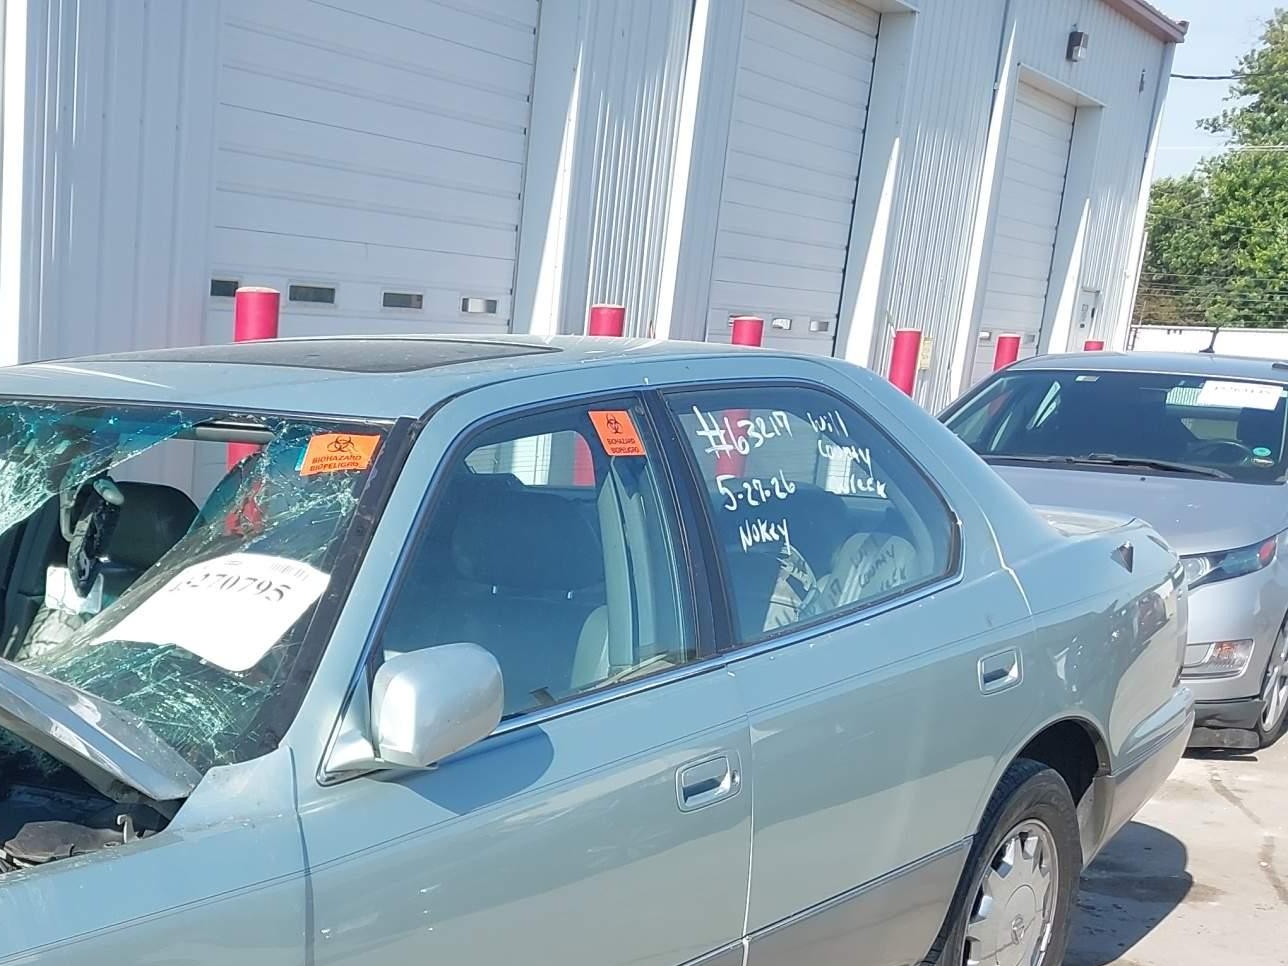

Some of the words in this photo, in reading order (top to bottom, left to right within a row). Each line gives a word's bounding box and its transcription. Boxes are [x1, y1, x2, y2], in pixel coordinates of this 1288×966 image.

[693, 405, 793, 459] #63217
[806, 410, 849, 438] Will
[312, 455, 362, 464] BIOHAZARD
